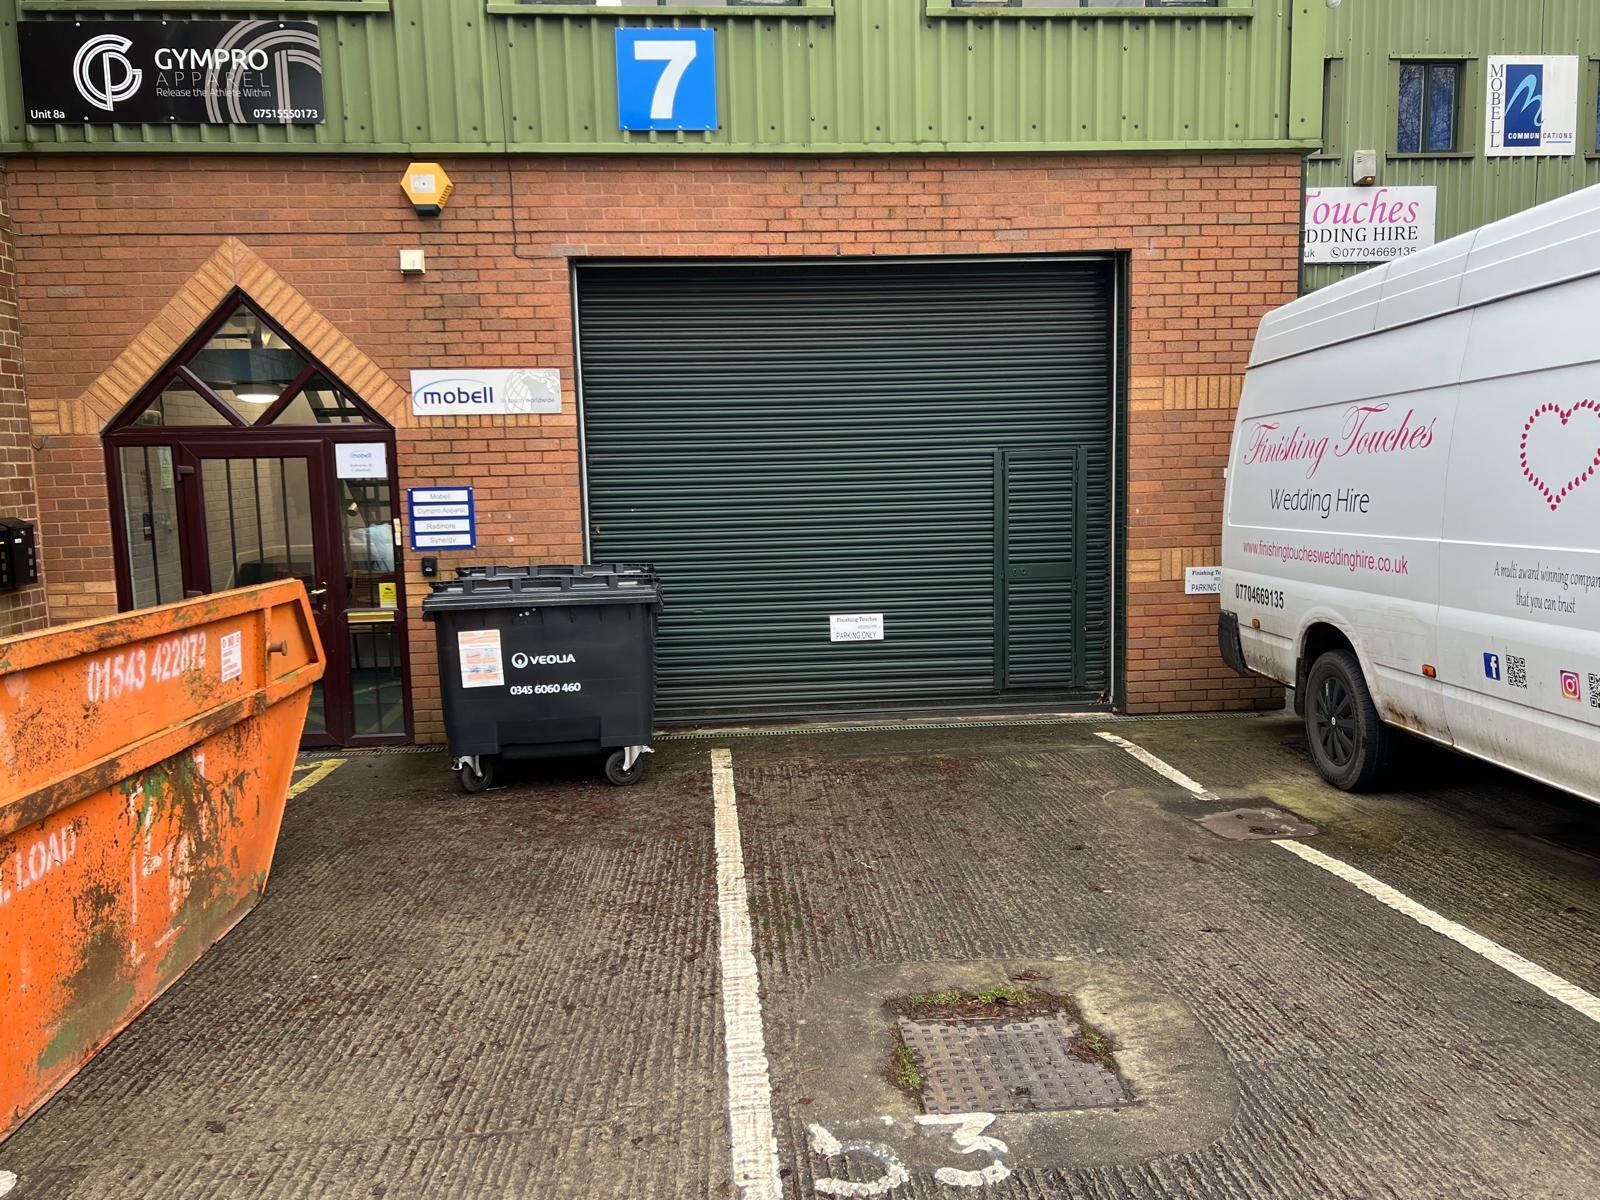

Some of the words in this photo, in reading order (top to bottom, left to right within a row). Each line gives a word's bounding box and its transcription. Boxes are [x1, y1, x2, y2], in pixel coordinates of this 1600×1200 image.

[154, 48, 269, 71] GYMPRO
[156, 71, 270, 88] APPAREL
[634, 40, 697, 119] 7
[156, 87, 191, 97] Release
[192, 87, 207, 97] the
[210, 87, 241, 97] Athlete
[242, 88, 271, 98] Within
[30, 109, 52, 119] Unit
[53, 109, 66, 119] 8a
[253, 108, 318, 119] 07515550173
[1490, 63, 1504, 148] MOBELL
[1373, 226, 1418, 241] HIRE
[423, 386, 494, 404] mobell
[1243, 422, 1330, 480] Finishing
[1334, 402, 1437, 458] Touches
[1270, 488, 1332, 519] Wedding
[1335, 488, 1370, 514] Hire
[1242, 539, 1409, 575] www.finishingtouchesweddinghire.co.uk
[1494, 560, 1500, 577] A
[1500, 559, 1518, 579] multi
[1518, 561, 1540, 581] award
[1540, 565, 1569, 591] winning
[1191, 583, 1217, 592] PARKING
[1235, 583, 1284, 609] 07704669135
[1515, 586, 1529, 607] that
[1530, 595, 1543, 614] you
[1543, 598, 1557, 611] can
[1557, 594, 1576, 614] trust
[836, 631, 861, 640] PARKING
[861, 631, 877, 639] ONLY
[529, 653, 576, 665] VEOLIA
[86, 649, 147, 702] 01543
[509, 685, 534, 696] 0345
[534, 683, 561, 695] 6060
[561, 682, 582, 693] 460
[15, 824, 77, 893] LOAD
